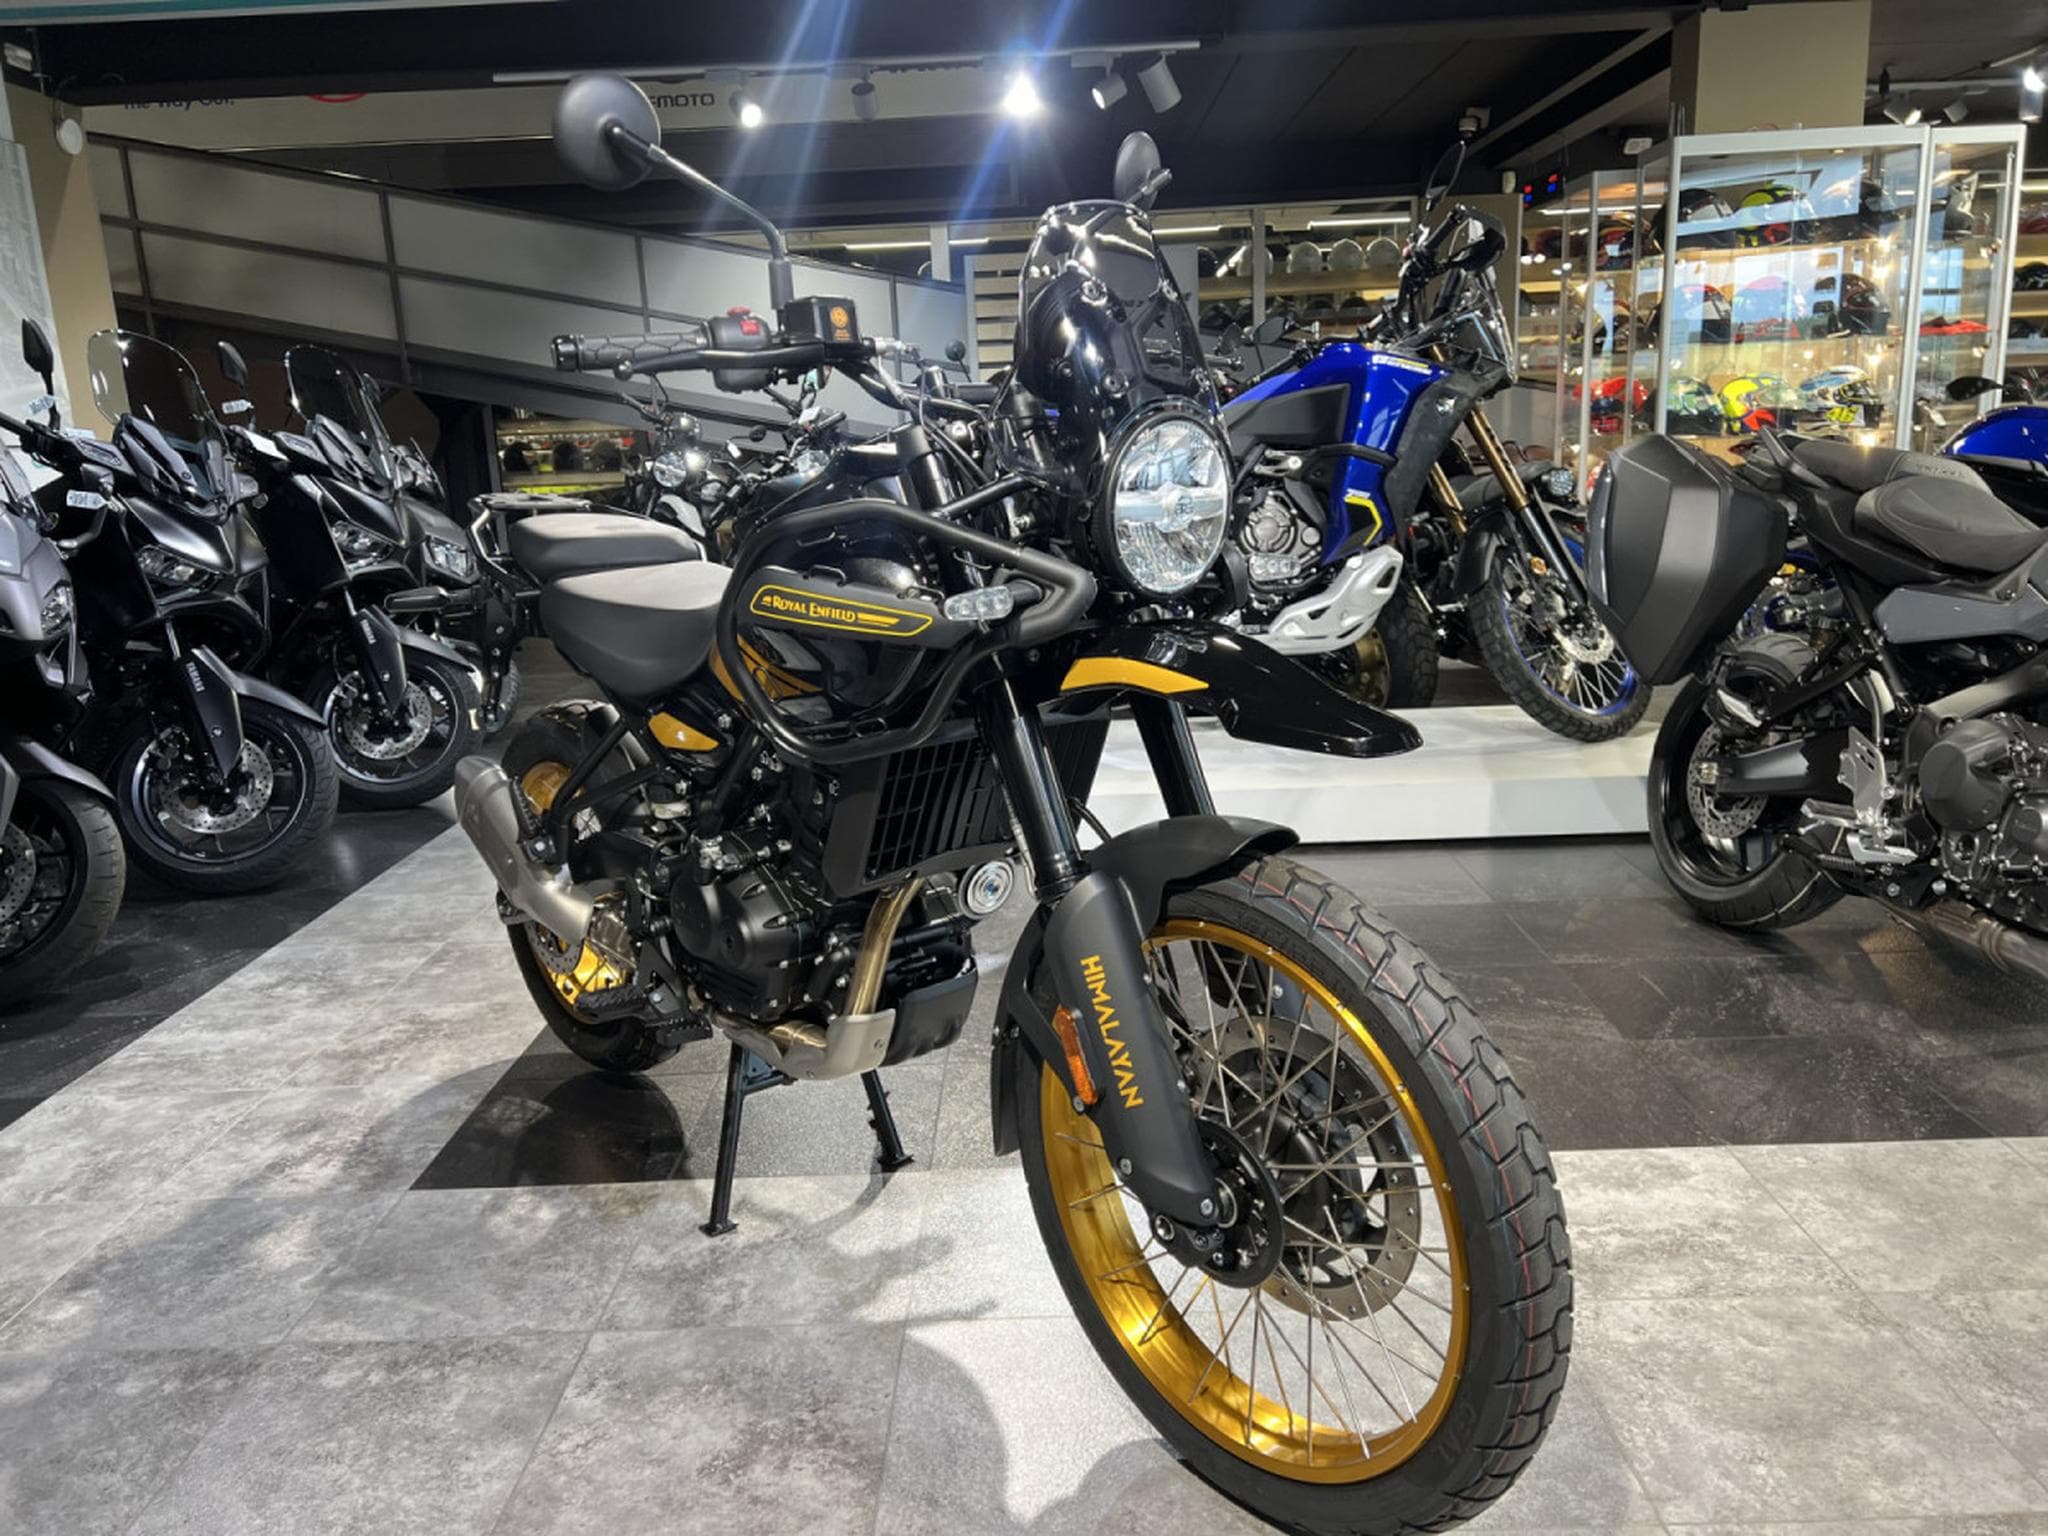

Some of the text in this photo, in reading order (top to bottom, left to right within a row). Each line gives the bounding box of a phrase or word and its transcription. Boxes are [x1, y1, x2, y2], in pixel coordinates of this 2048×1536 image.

[1825, 405, 1859, 423] 46
[772, 595, 856, 622] ROYAL ENFIELD
[1080, 954, 1144, 1109] HIMALAYAN
